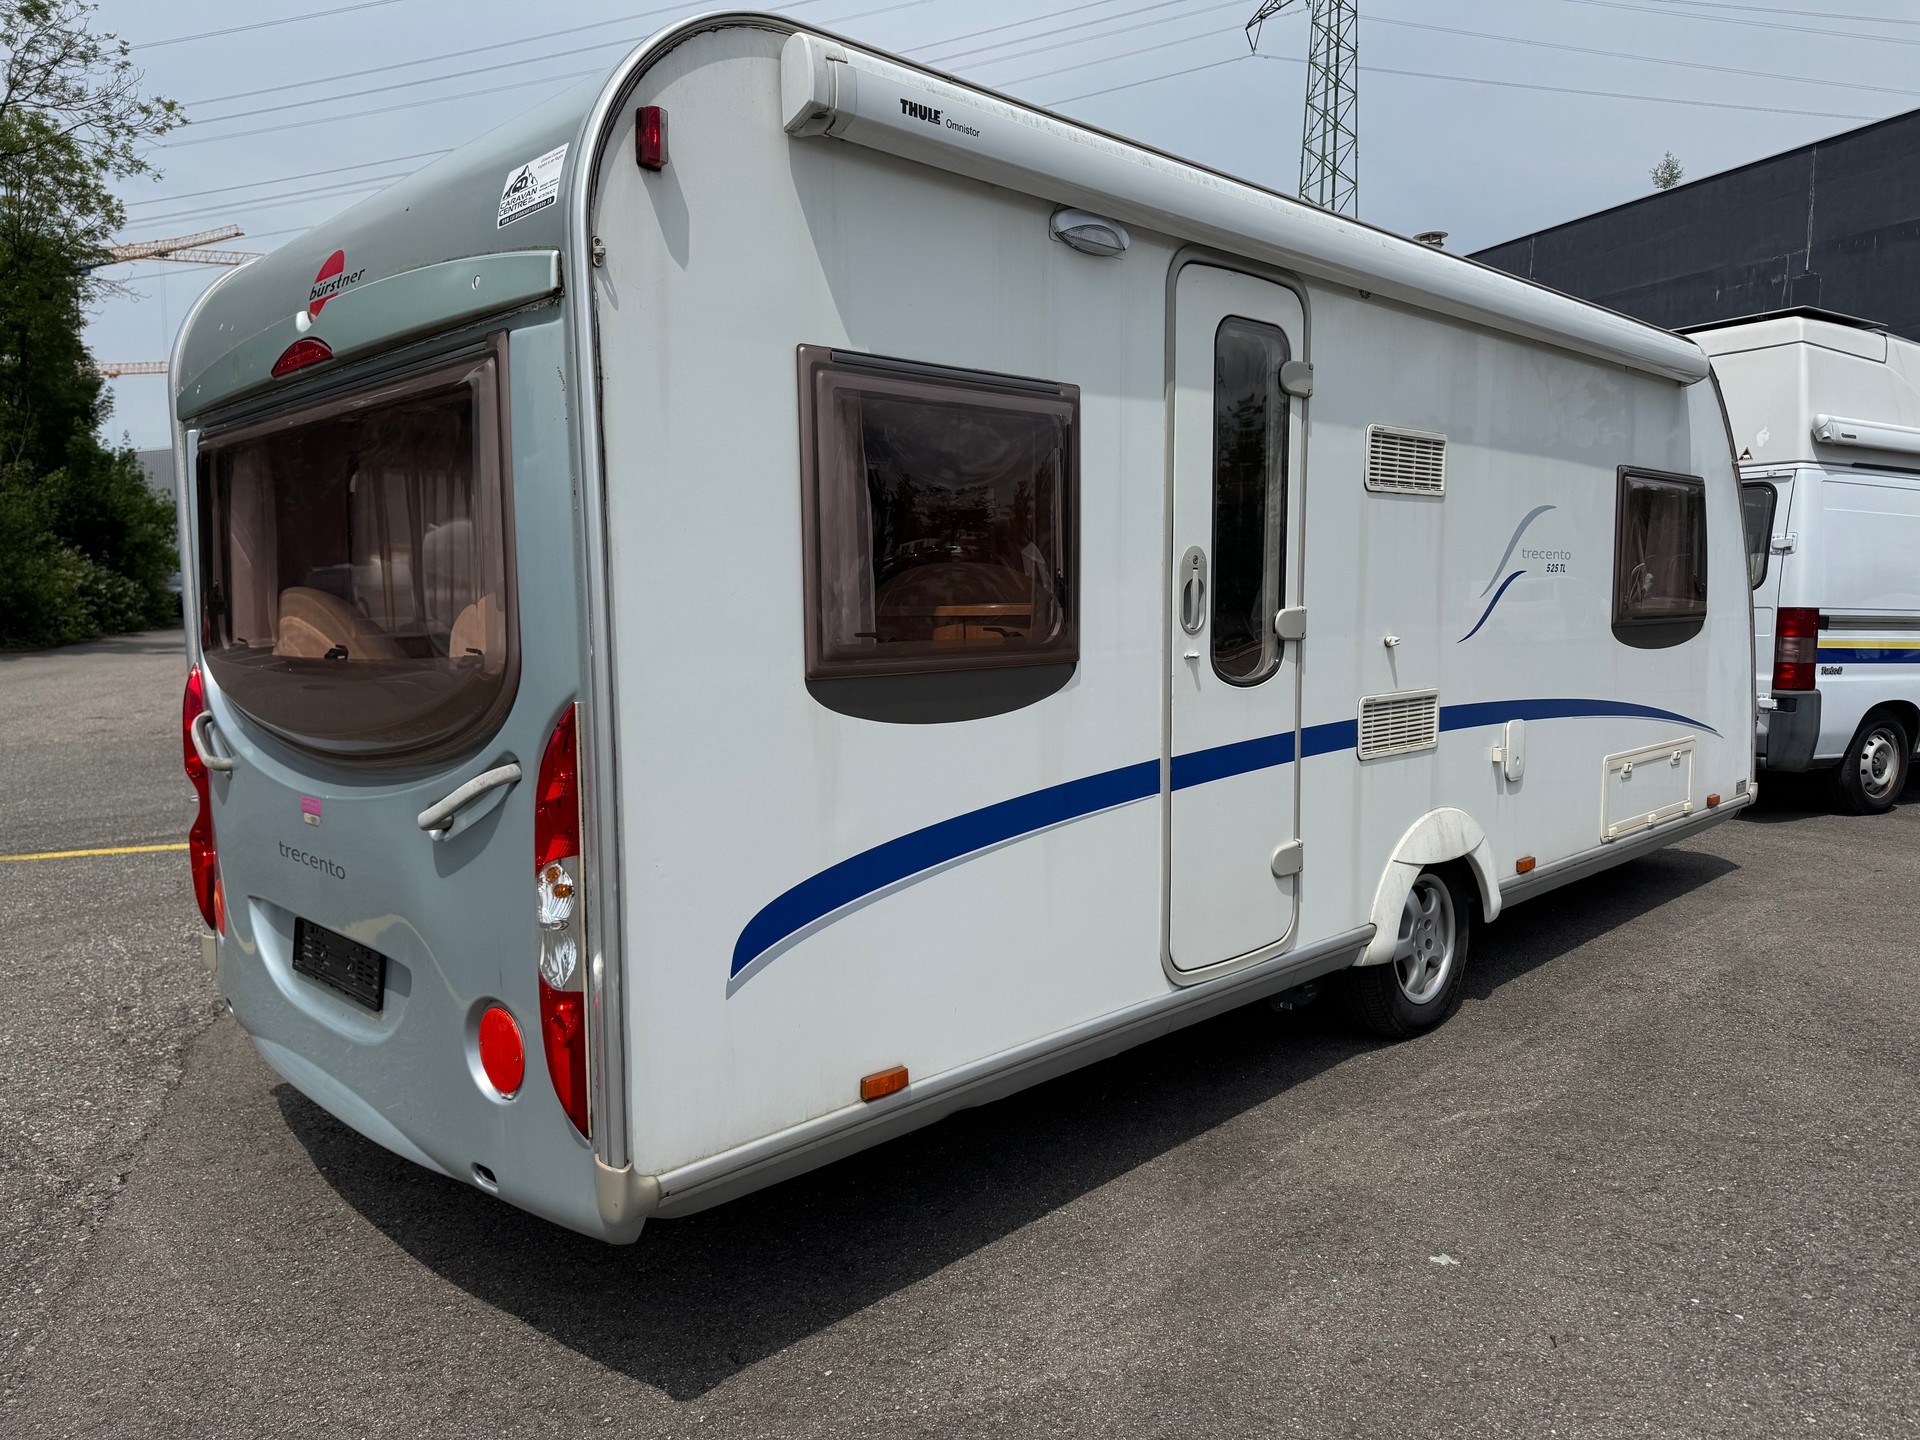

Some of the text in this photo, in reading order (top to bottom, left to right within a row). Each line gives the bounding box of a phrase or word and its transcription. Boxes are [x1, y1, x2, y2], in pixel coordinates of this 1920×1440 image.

[900, 98, 980, 137] THULE Omnistor
[499, 199, 528, 217] CENTRE
[500, 187, 538, 210] CARAVAN
[309, 269, 366, 301] bürstner
[1522, 547, 1572, 561] trecento
[1546, 563, 1566, 573] 525 TL
[279, 841, 346, 880] trecento
